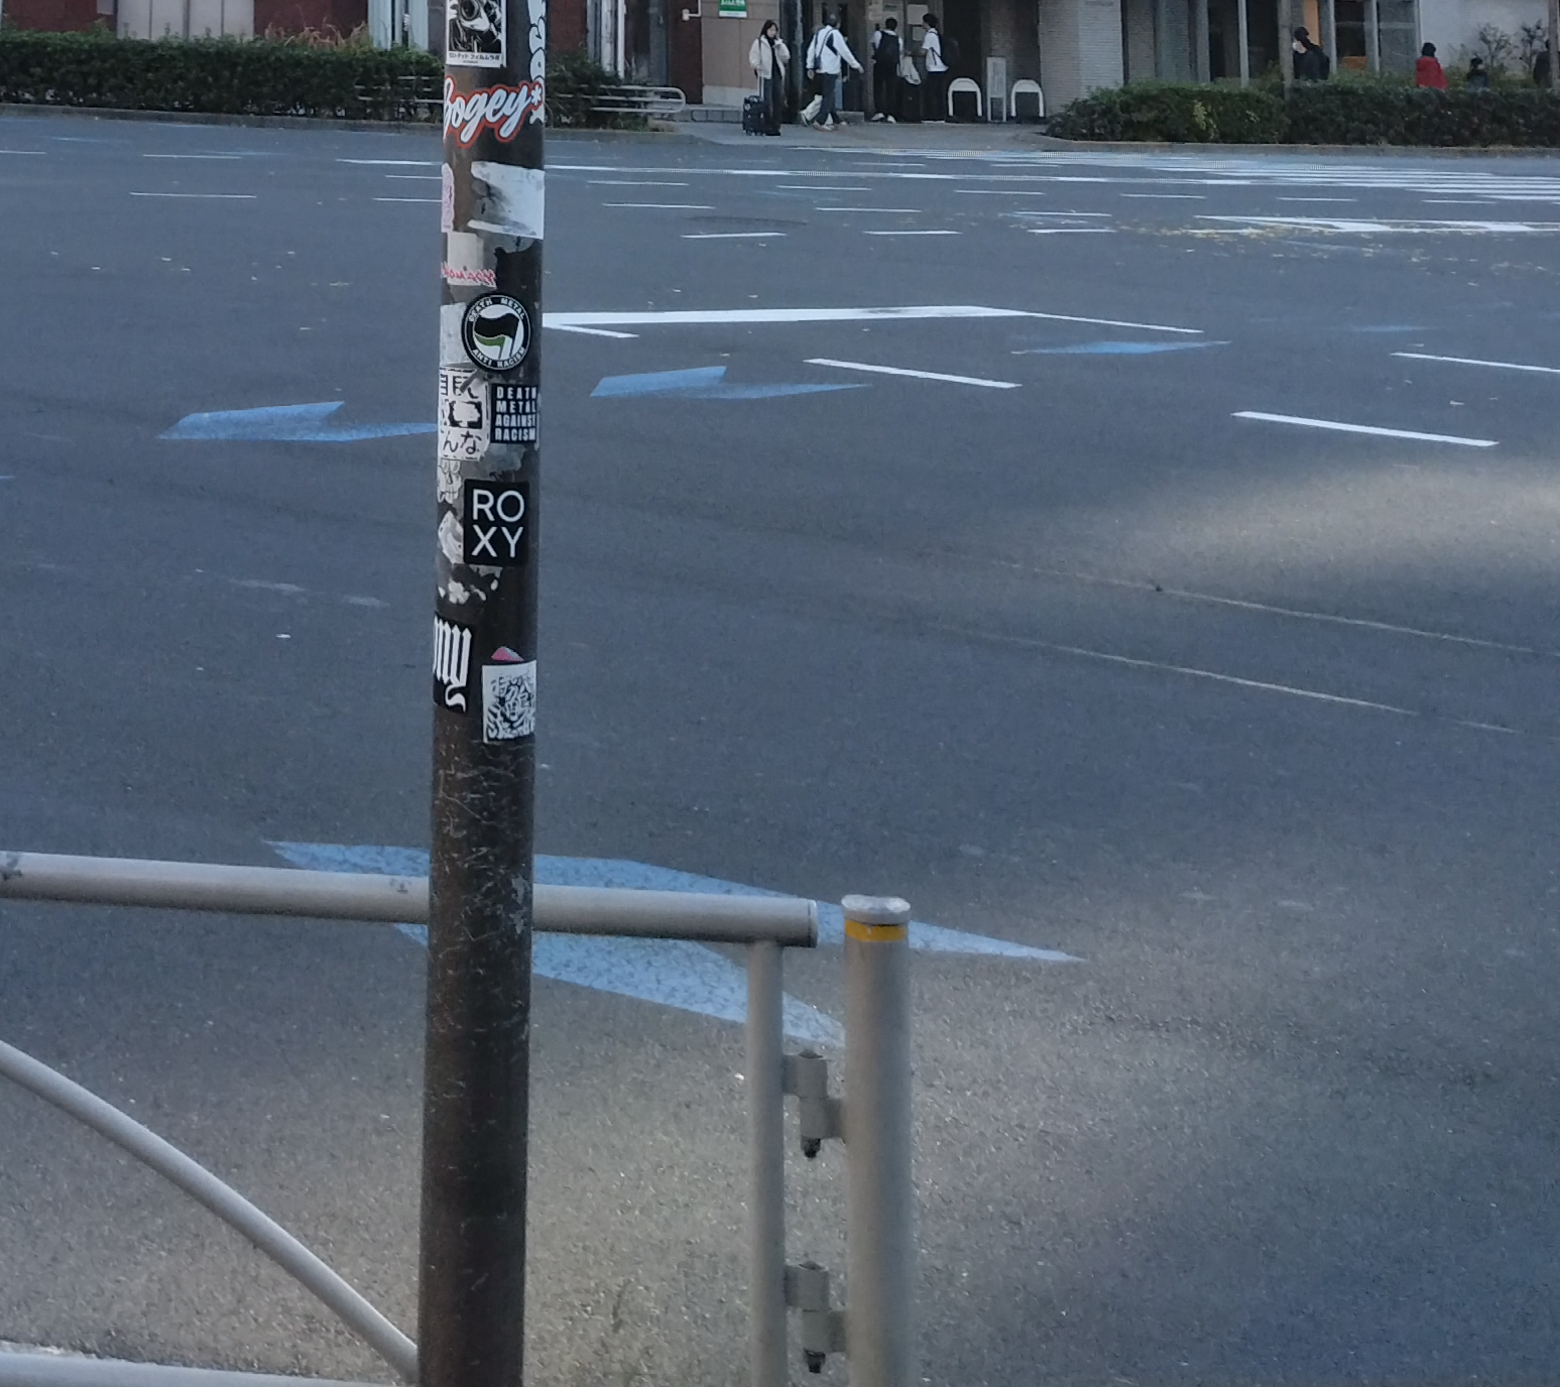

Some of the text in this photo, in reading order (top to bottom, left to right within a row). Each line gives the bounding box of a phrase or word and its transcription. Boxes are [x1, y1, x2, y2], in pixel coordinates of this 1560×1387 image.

[500, 296, 526, 320] METAL
[472, 346, 526, 368] ANTI RACISM
[496, 386, 537, 400] DEATH
[496, 400, 537, 414] METAL
[495, 414, 536, 427] AGAINST
[495, 427, 536, 441] RACISM
[472, 488, 525, 523] RO
[471, 524, 524, 558] XY
